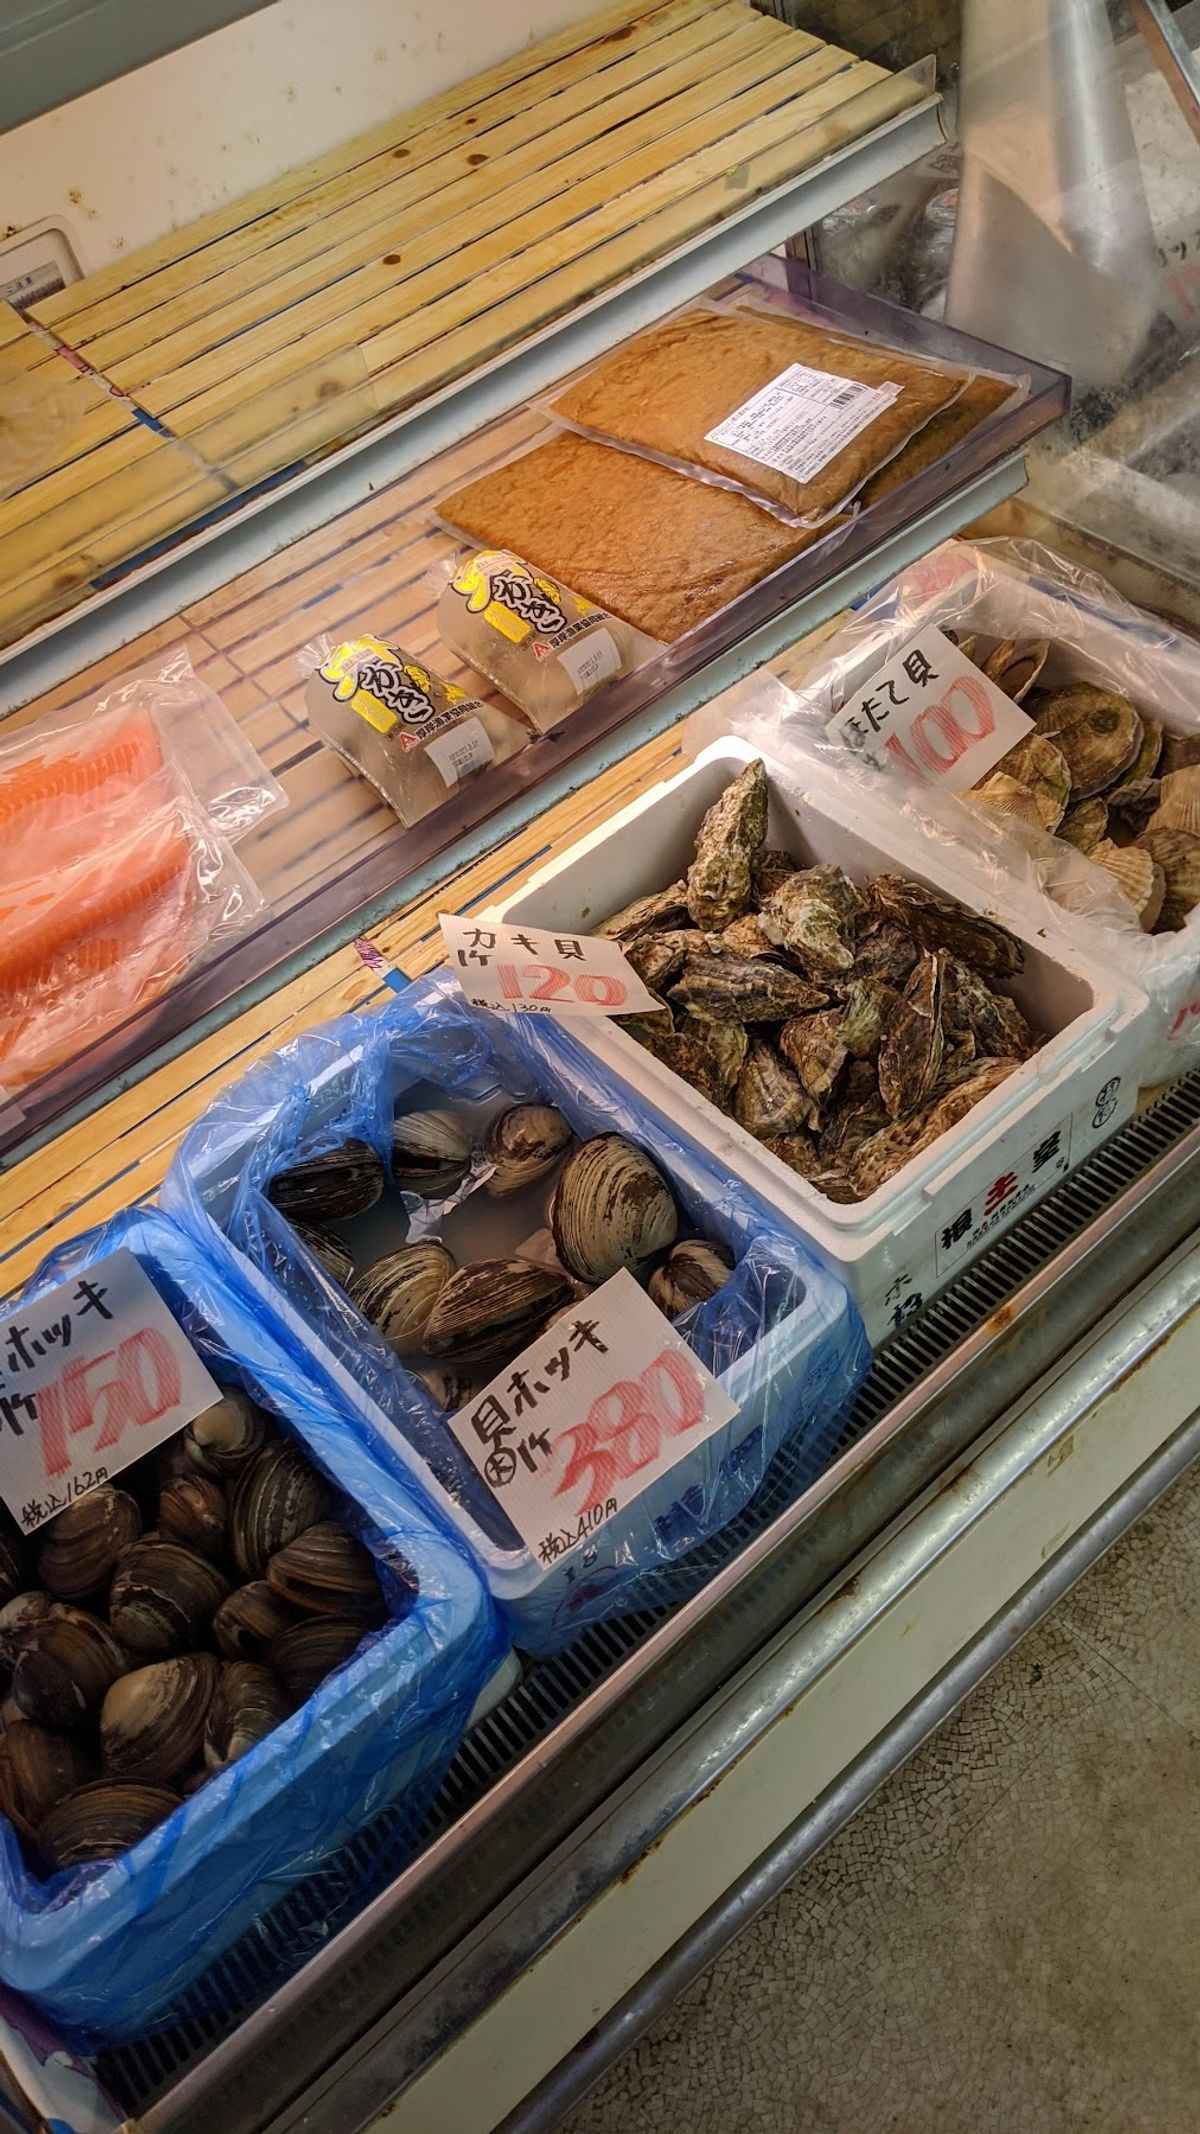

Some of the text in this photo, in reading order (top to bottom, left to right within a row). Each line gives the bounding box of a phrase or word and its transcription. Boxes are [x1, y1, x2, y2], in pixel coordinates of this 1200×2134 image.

[462, 927, 587, 961] カキ貝
[496, 964, 628, 1006] 120
[0, 1280, 112, 1389] ホッキ
[470, 1318, 610, 1450] 貝ホッキ
[37, 1326, 182, 1477] 150
[549, 1348, 706, 1516] 380
